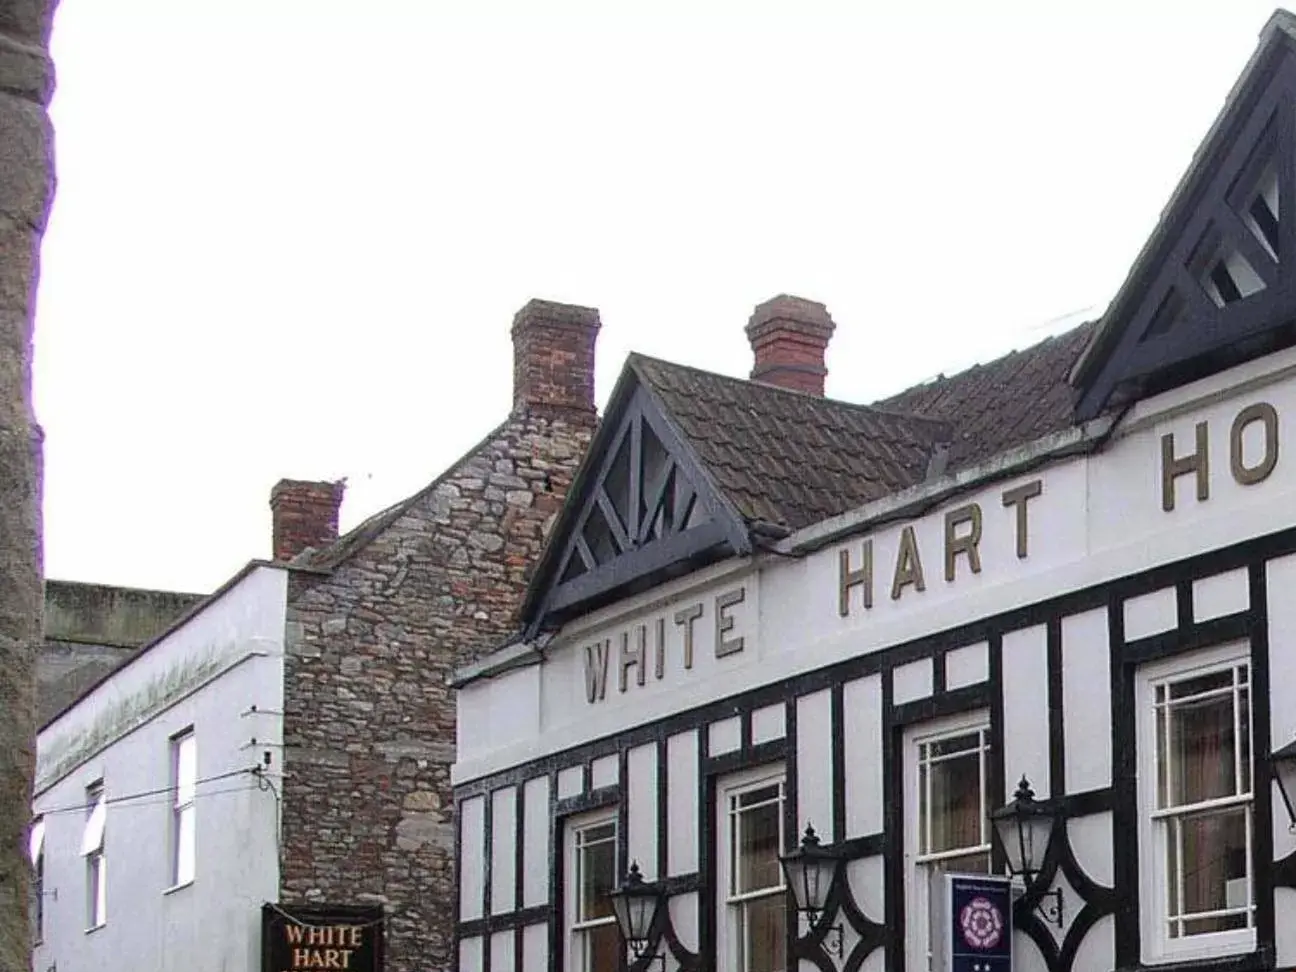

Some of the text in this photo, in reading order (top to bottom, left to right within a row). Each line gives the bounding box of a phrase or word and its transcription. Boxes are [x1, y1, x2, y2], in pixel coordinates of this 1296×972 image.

[582, 587, 746, 703] WHITE
[838, 479, 1043, 617] HART
[284, 924, 363, 946] WHITE
[293, 948, 353, 968] HART
